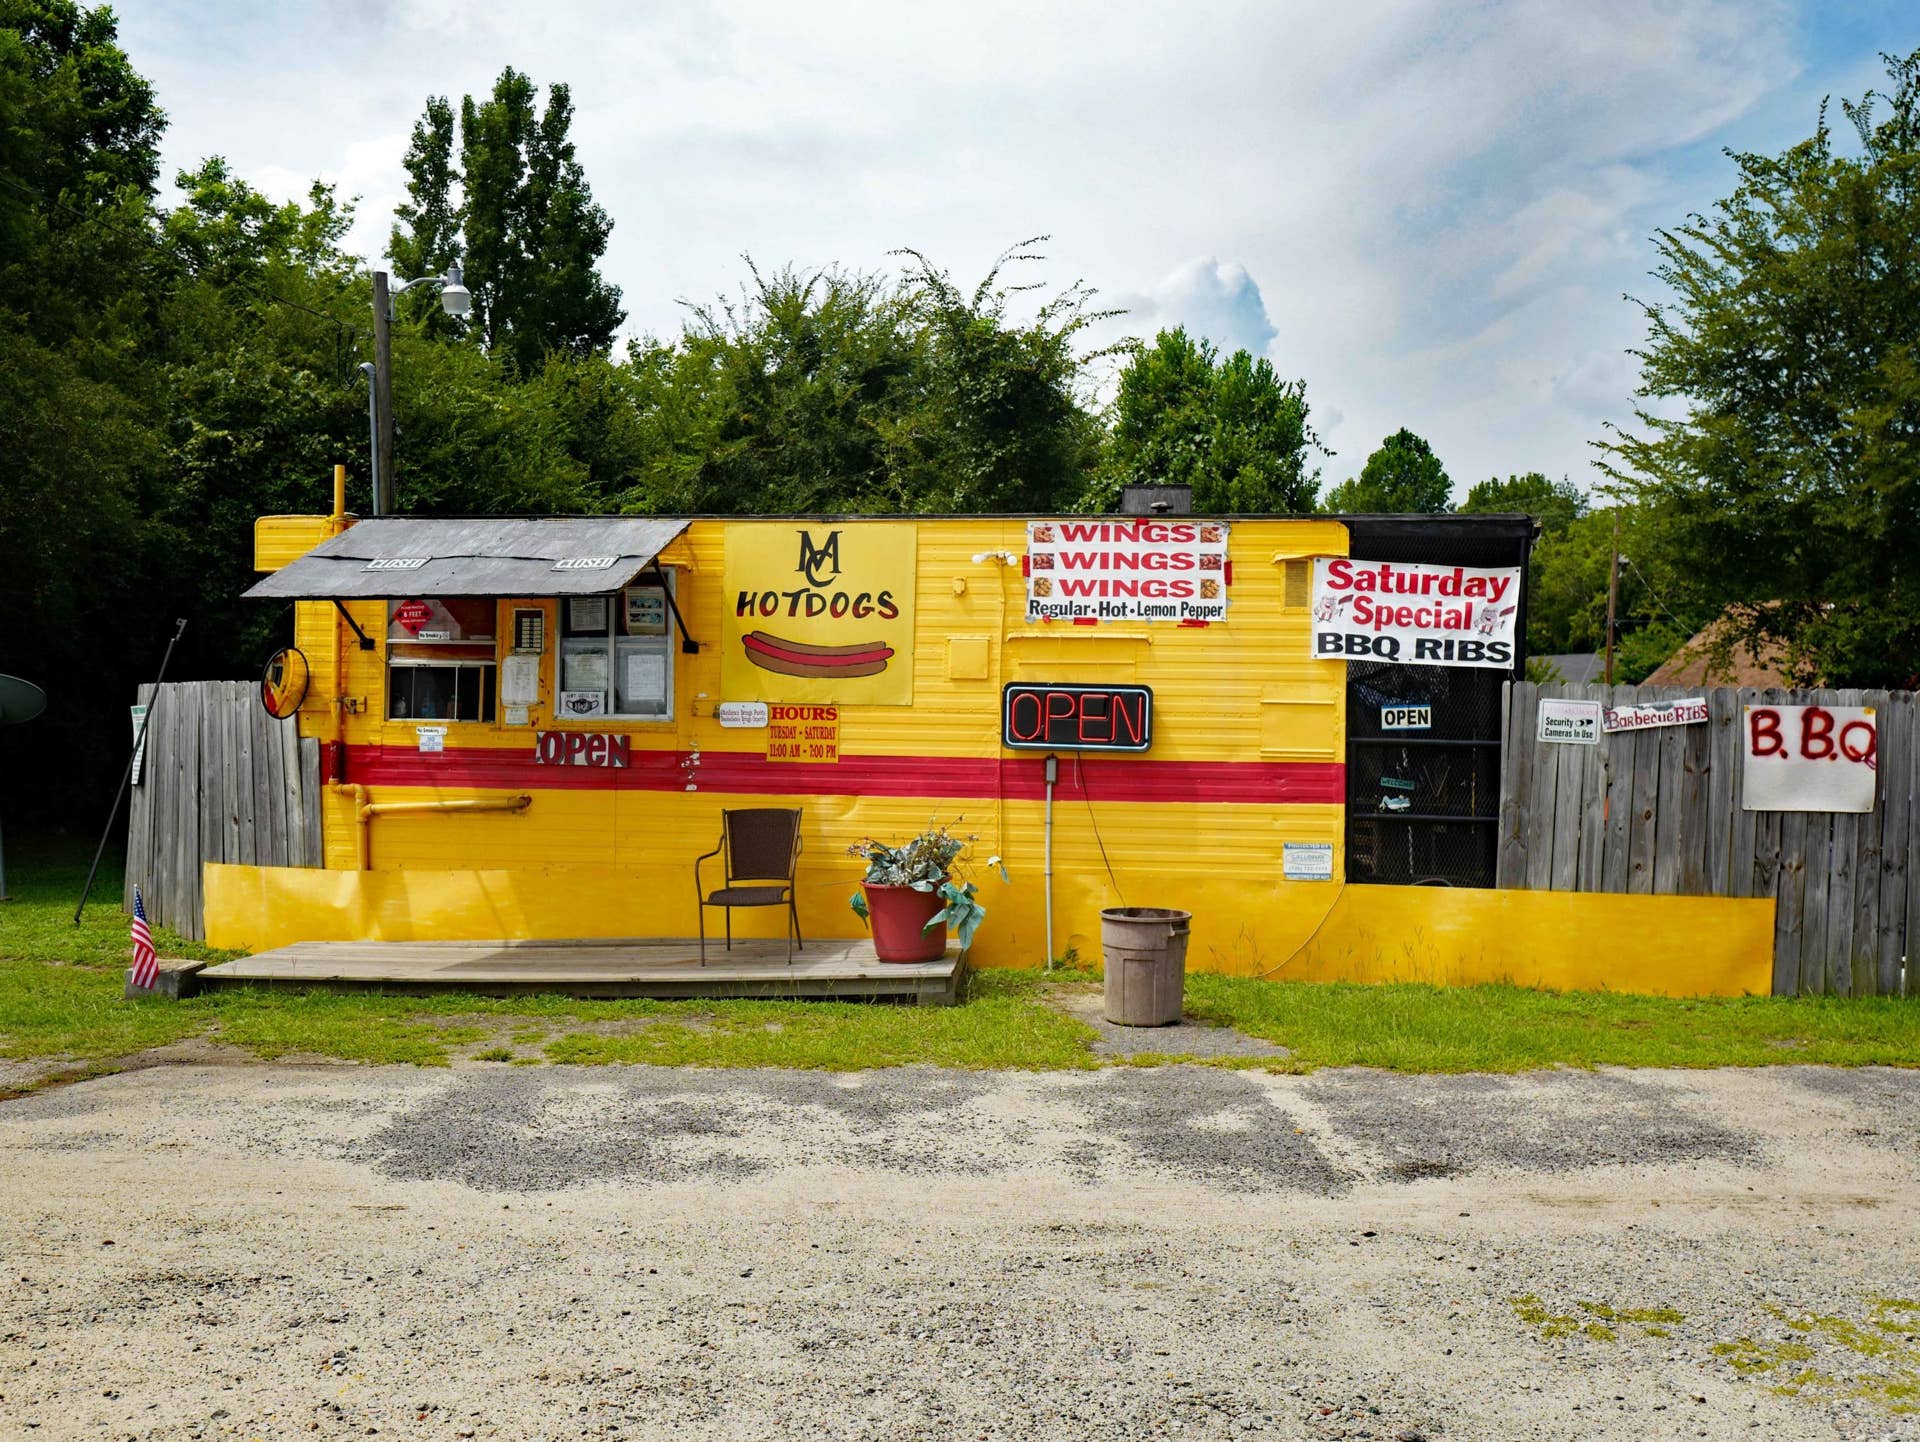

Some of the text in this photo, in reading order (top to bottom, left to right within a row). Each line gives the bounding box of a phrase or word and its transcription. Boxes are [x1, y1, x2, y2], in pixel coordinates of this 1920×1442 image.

[1060, 524, 1196, 544] WINGS
[366, 557, 428, 570] CLOSED
[555, 556, 618, 570] CLOSED
[1059, 551, 1196, 571] WINGS
[1058, 579, 1195, 598] WINGS
[1326, 559, 1511, 604] Saturday
[736, 587, 899, 620] HOTDOGS
[1029, 599, 1223, 620] Regular Hot Lemon Pepper
[1352, 595, 1473, 632] Special
[1317, 632, 1512, 663] BBQ RIBS
[771, 707, 837, 720] HOURS
[1011, 692, 1143, 744] OPEN
[1384, 709, 1429, 726] OPEN
[1545, 716, 1574, 729] Security
[1674, 703, 1709, 723] RIBS
[770, 726, 797, 739] TUESDAY
[805, 726, 836, 740] SATURDAY
[1545, 727, 1594, 739] Cameras In Use
[770, 744, 786, 757] 11:00
[790, 744, 800, 757] AM
[810, 744, 823, 758] 7:00
[826, 745, 836, 758] PM
